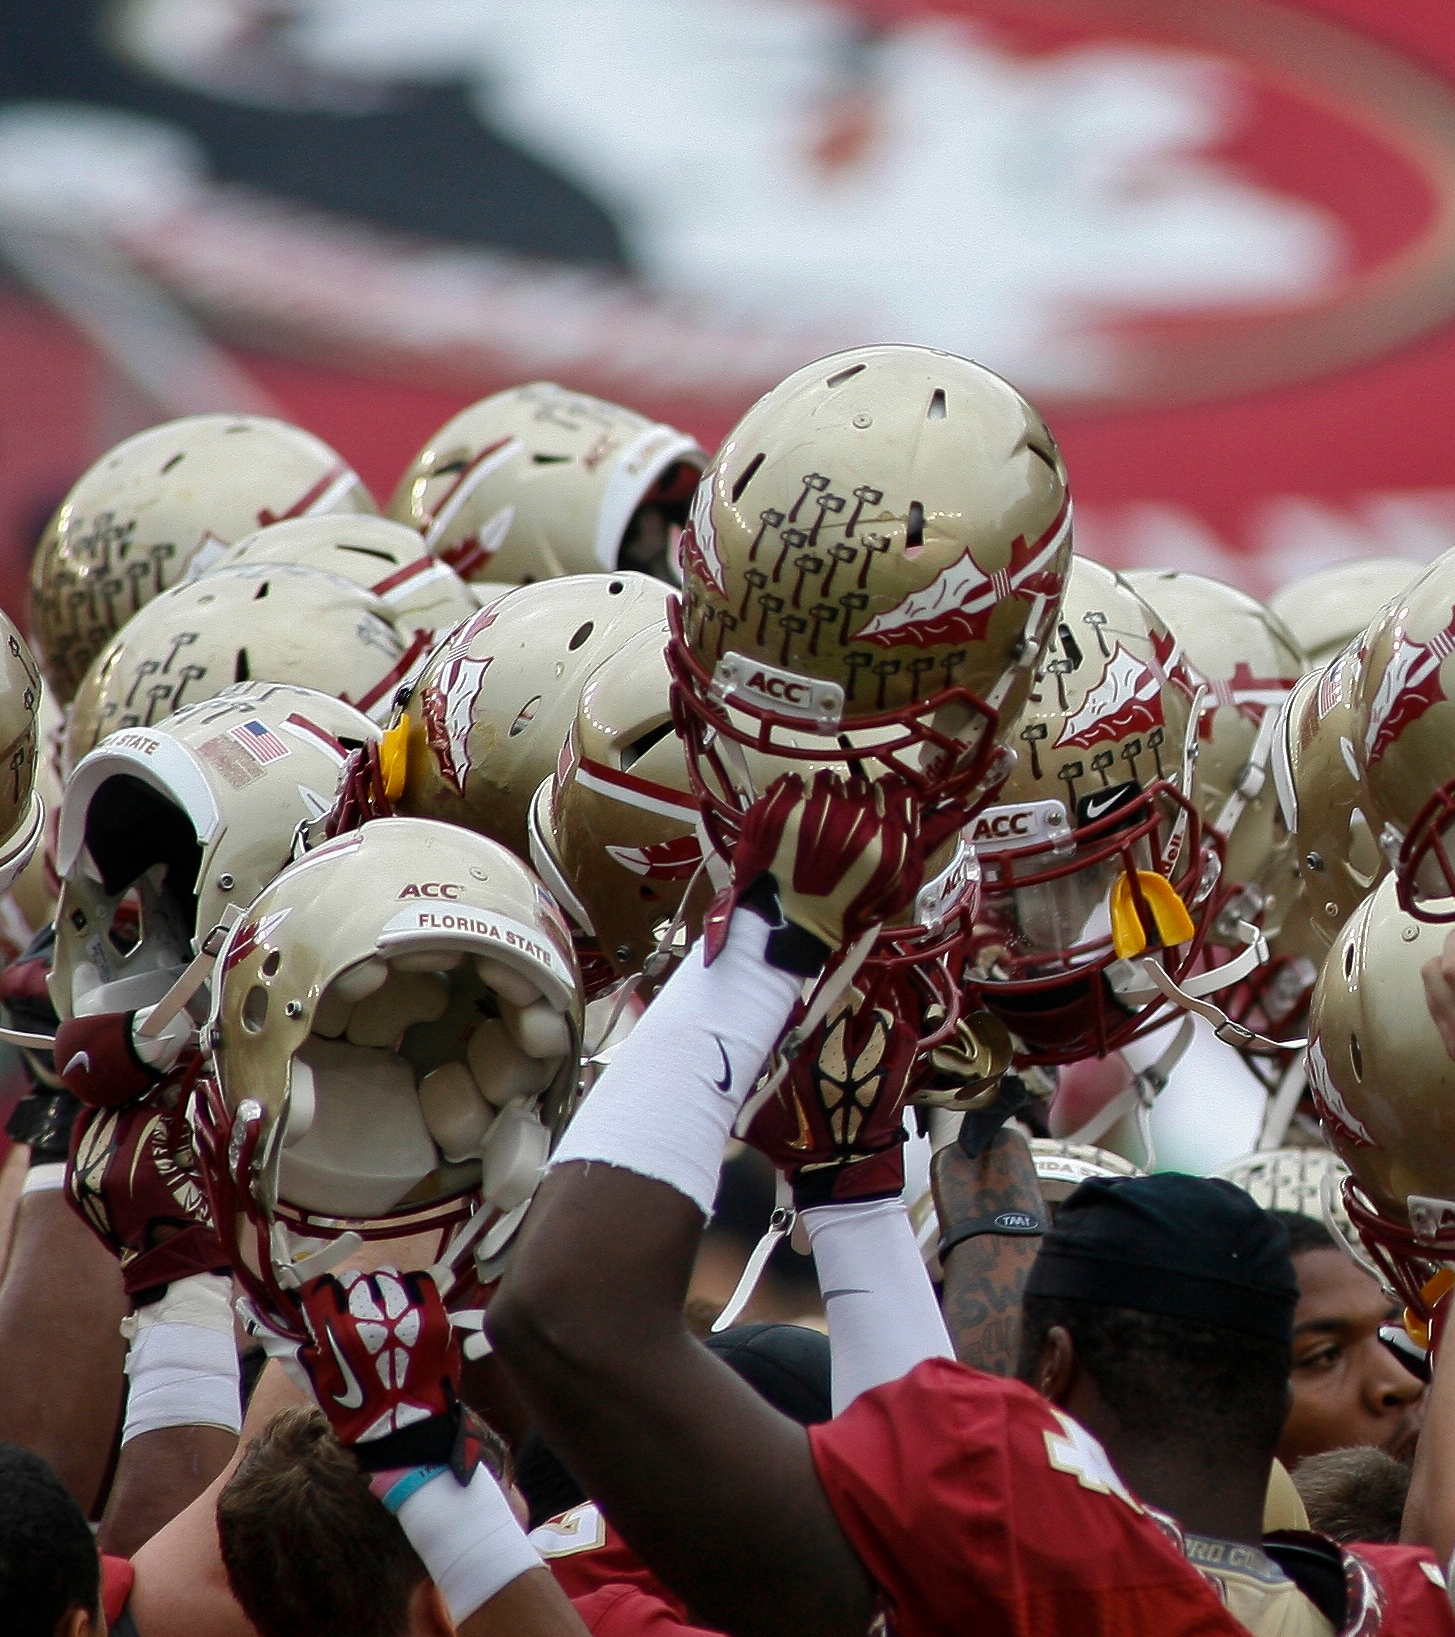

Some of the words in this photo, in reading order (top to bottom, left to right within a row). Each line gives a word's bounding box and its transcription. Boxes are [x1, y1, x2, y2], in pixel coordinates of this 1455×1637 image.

[746, 671, 803, 703] ACC
[115, 734, 160, 756] STATE
[972, 812, 1030, 840] ACC
[398, 882, 460, 900] ACC
[418, 913, 501, 940] FLORIDA
[505, 930, 551, 966] STATE
